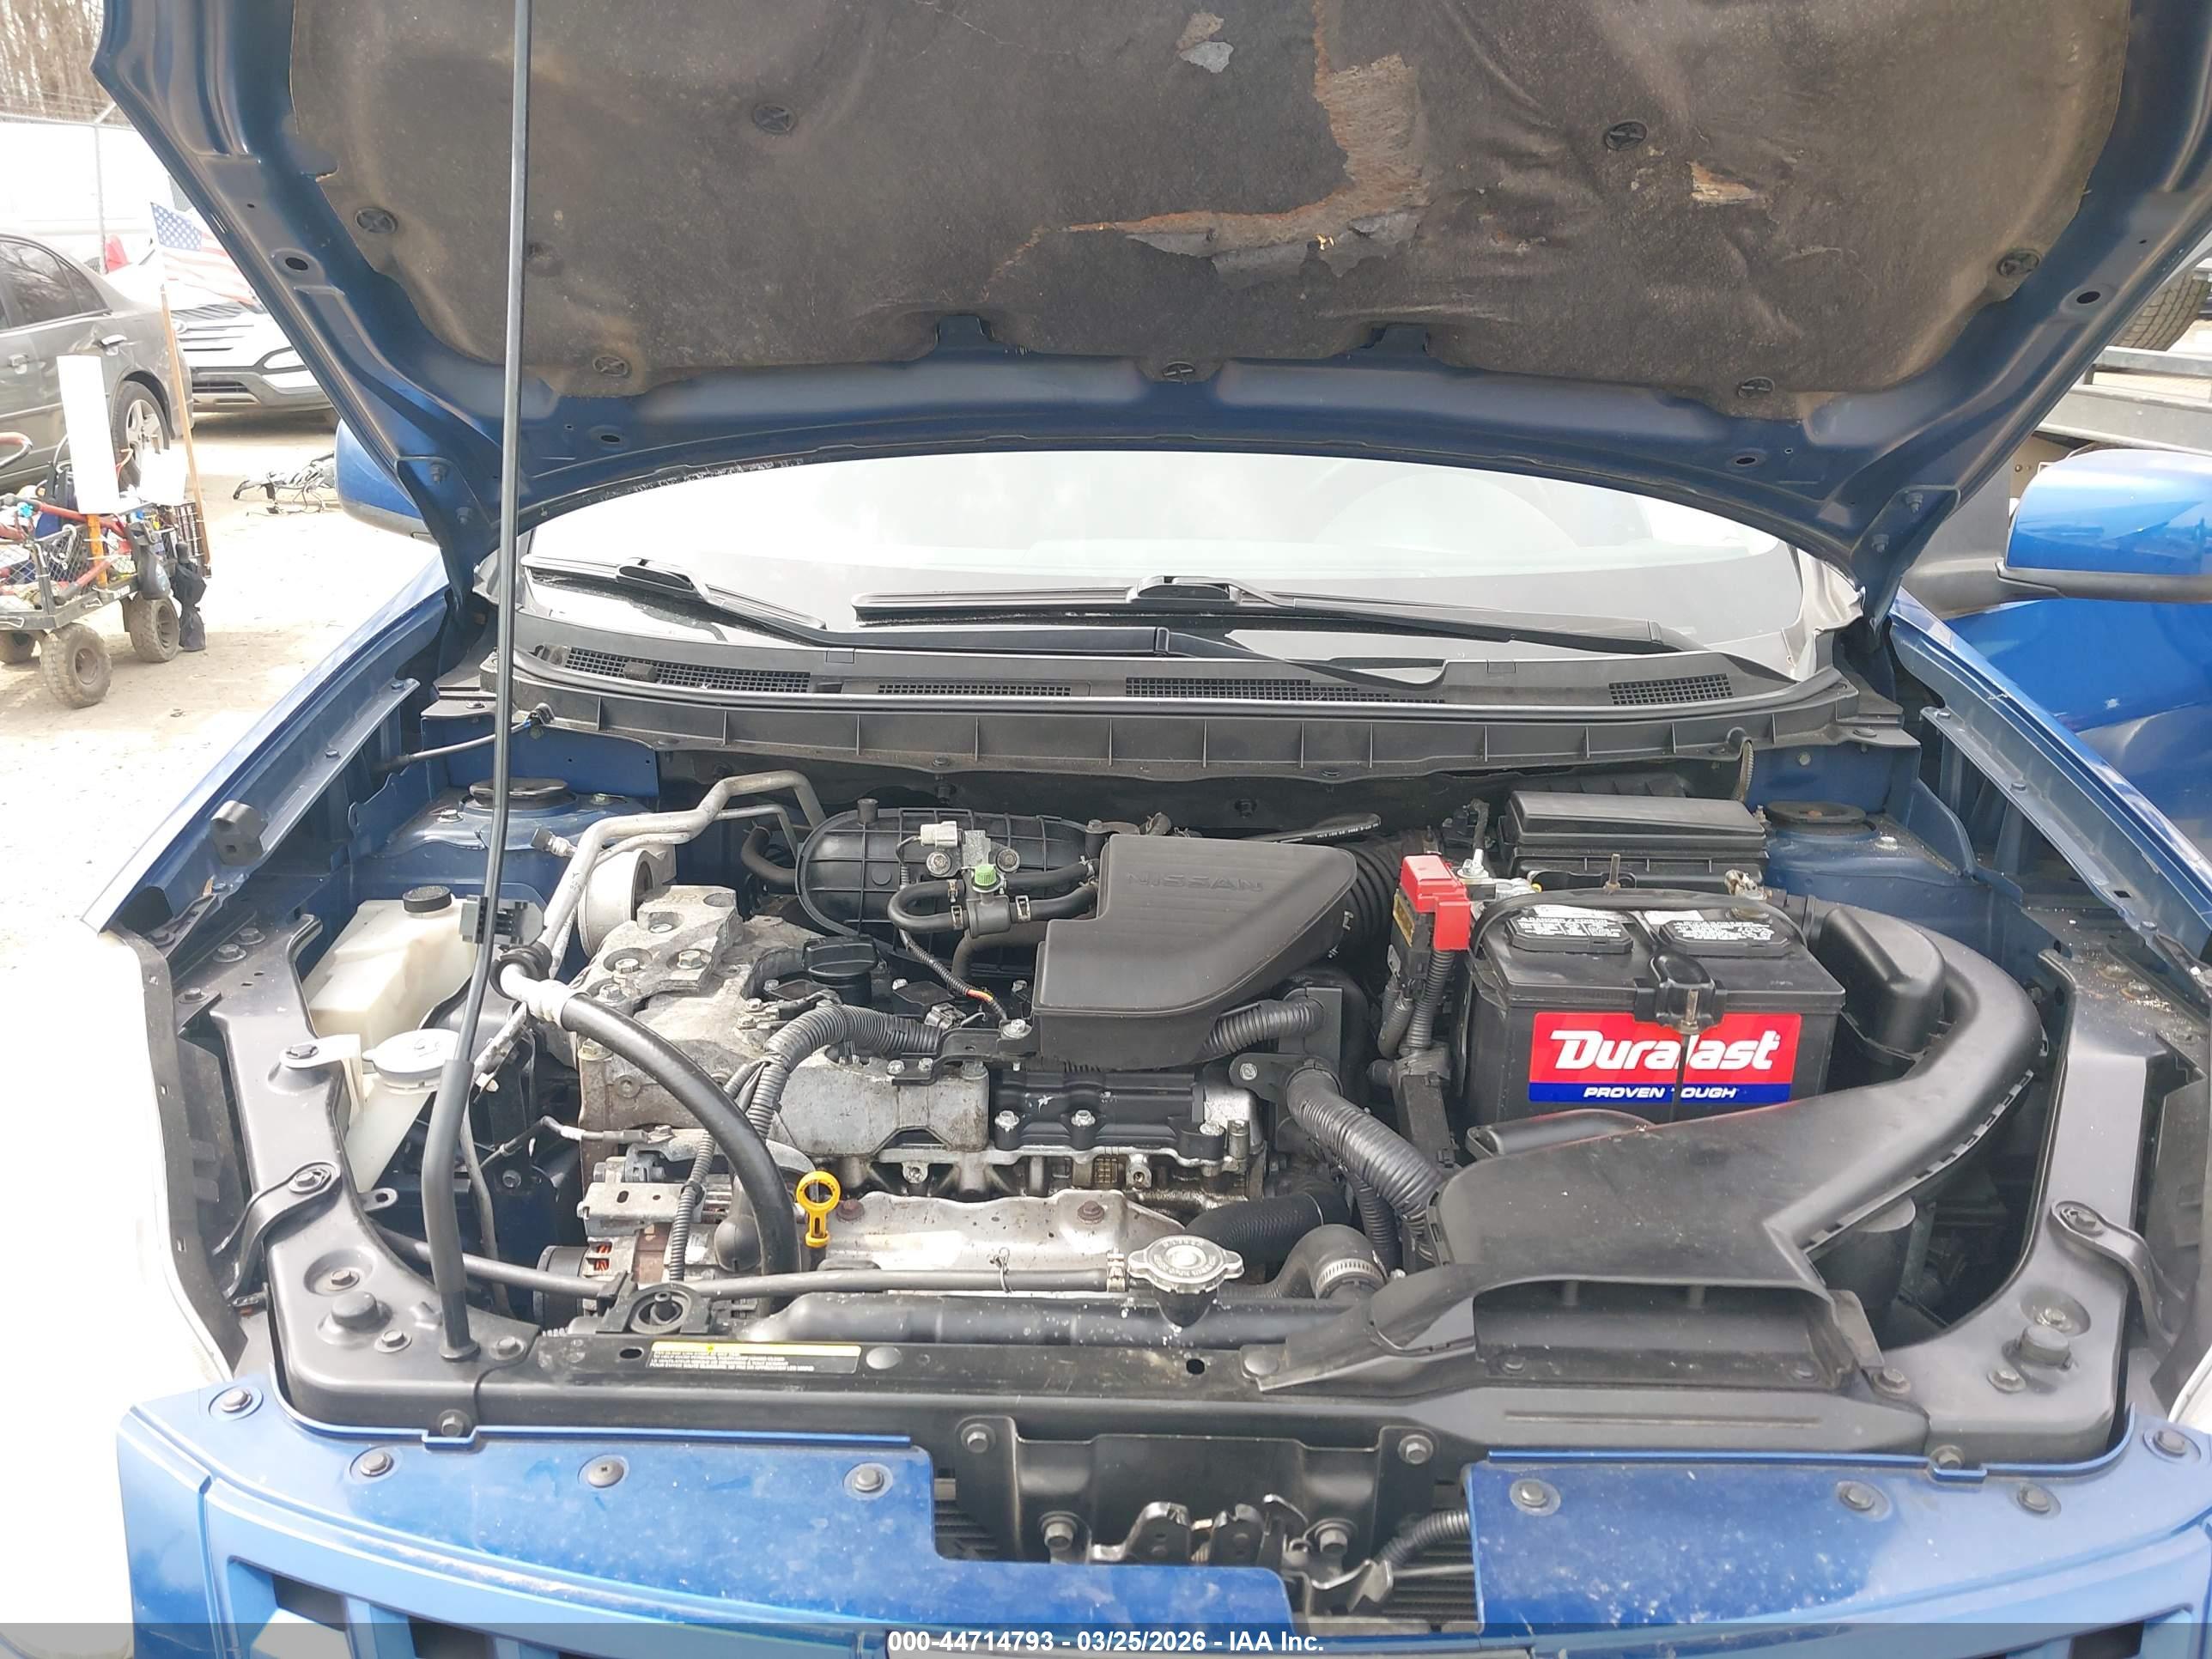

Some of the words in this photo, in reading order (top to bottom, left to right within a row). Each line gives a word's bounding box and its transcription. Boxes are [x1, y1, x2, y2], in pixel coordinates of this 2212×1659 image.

[1126, 872, 1264, 893] NISSAN
[1549, 1030, 1780, 1070] Duralast
[1583, 1086, 1665, 1098] PROVEN
[1670, 1086, 1736, 1099] OUGH
